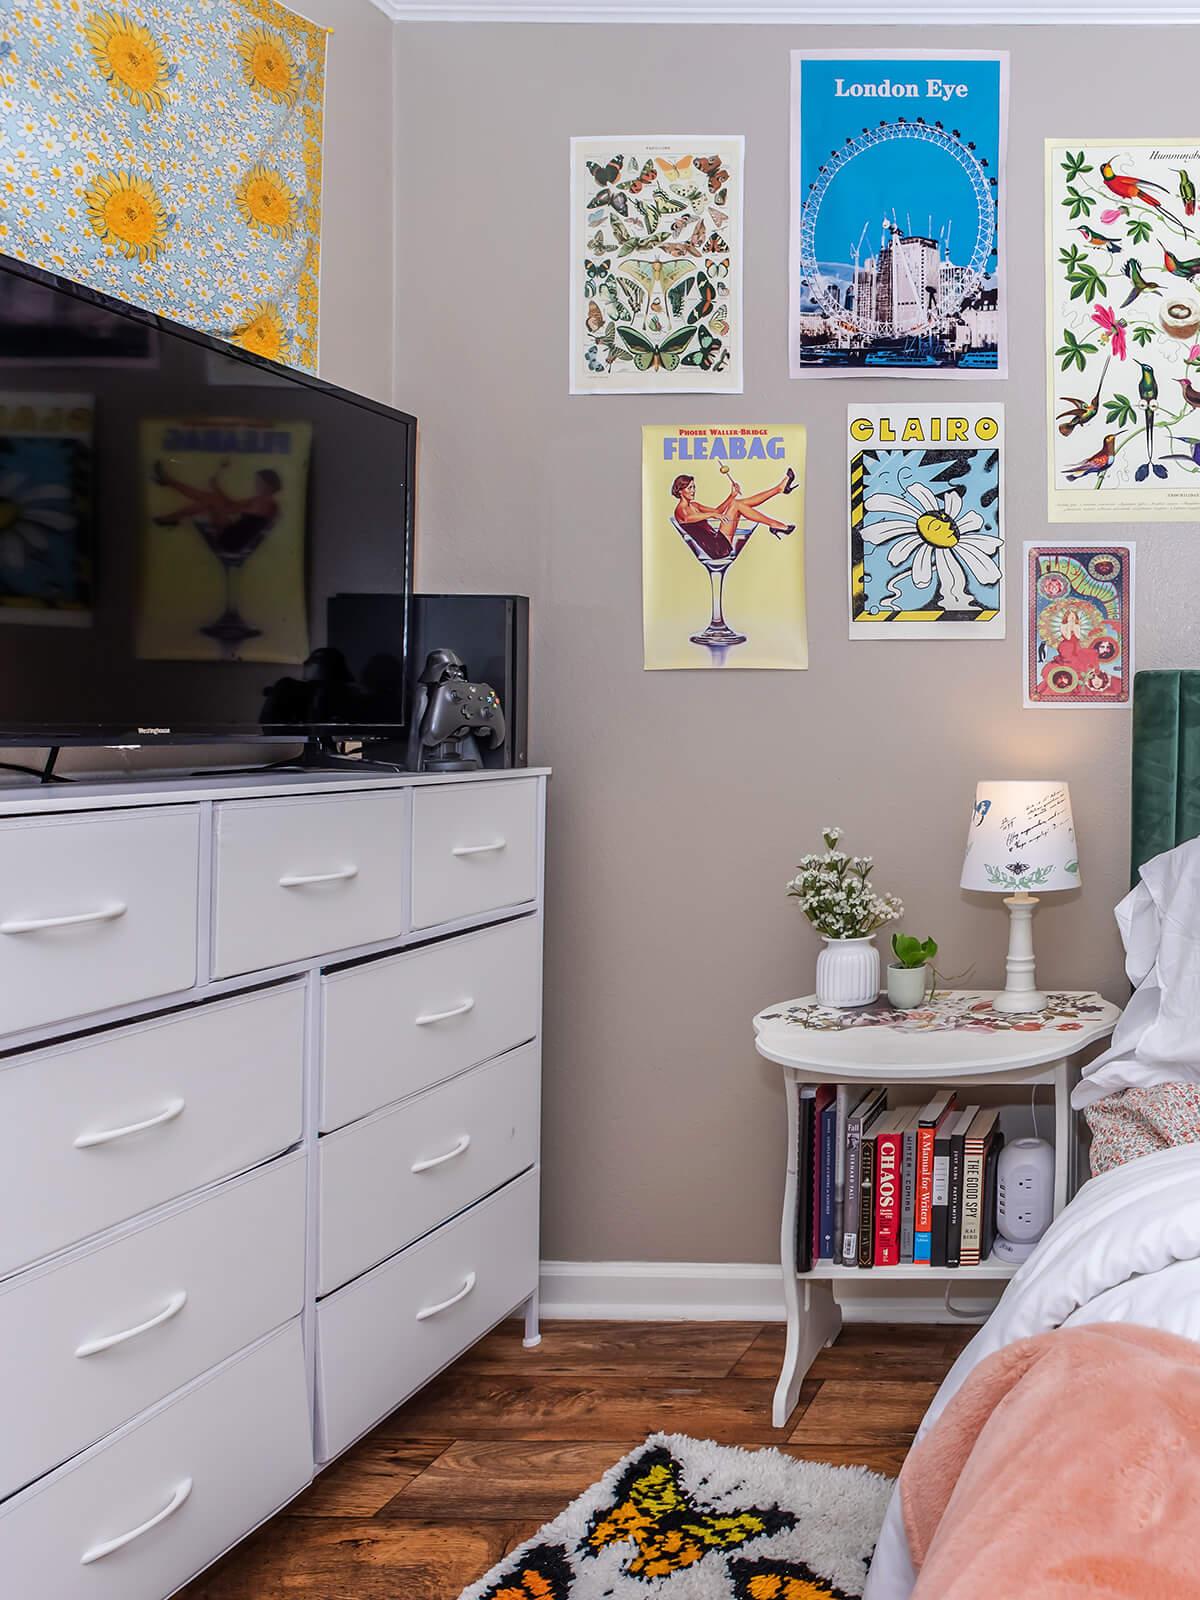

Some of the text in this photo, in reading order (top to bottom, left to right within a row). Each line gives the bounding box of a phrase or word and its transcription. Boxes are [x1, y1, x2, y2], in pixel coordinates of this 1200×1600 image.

[834, 78, 968, 101] London Eye
[710, 428, 769, 436] WALLER-BRIDGE
[849, 417, 999, 442] CLAIRO
[663, 437, 785, 460] FLEABAG
[848, 1123, 859, 1131] Fall
[921, 1141, 931, 1175] Manual
[880, 1142, 896, 1207] CHAOS
[921, 1177, 930, 1189] for
[965, 1160, 979, 1218] THE GOOD SPY
[920, 1190, 931, 1225] Writers
